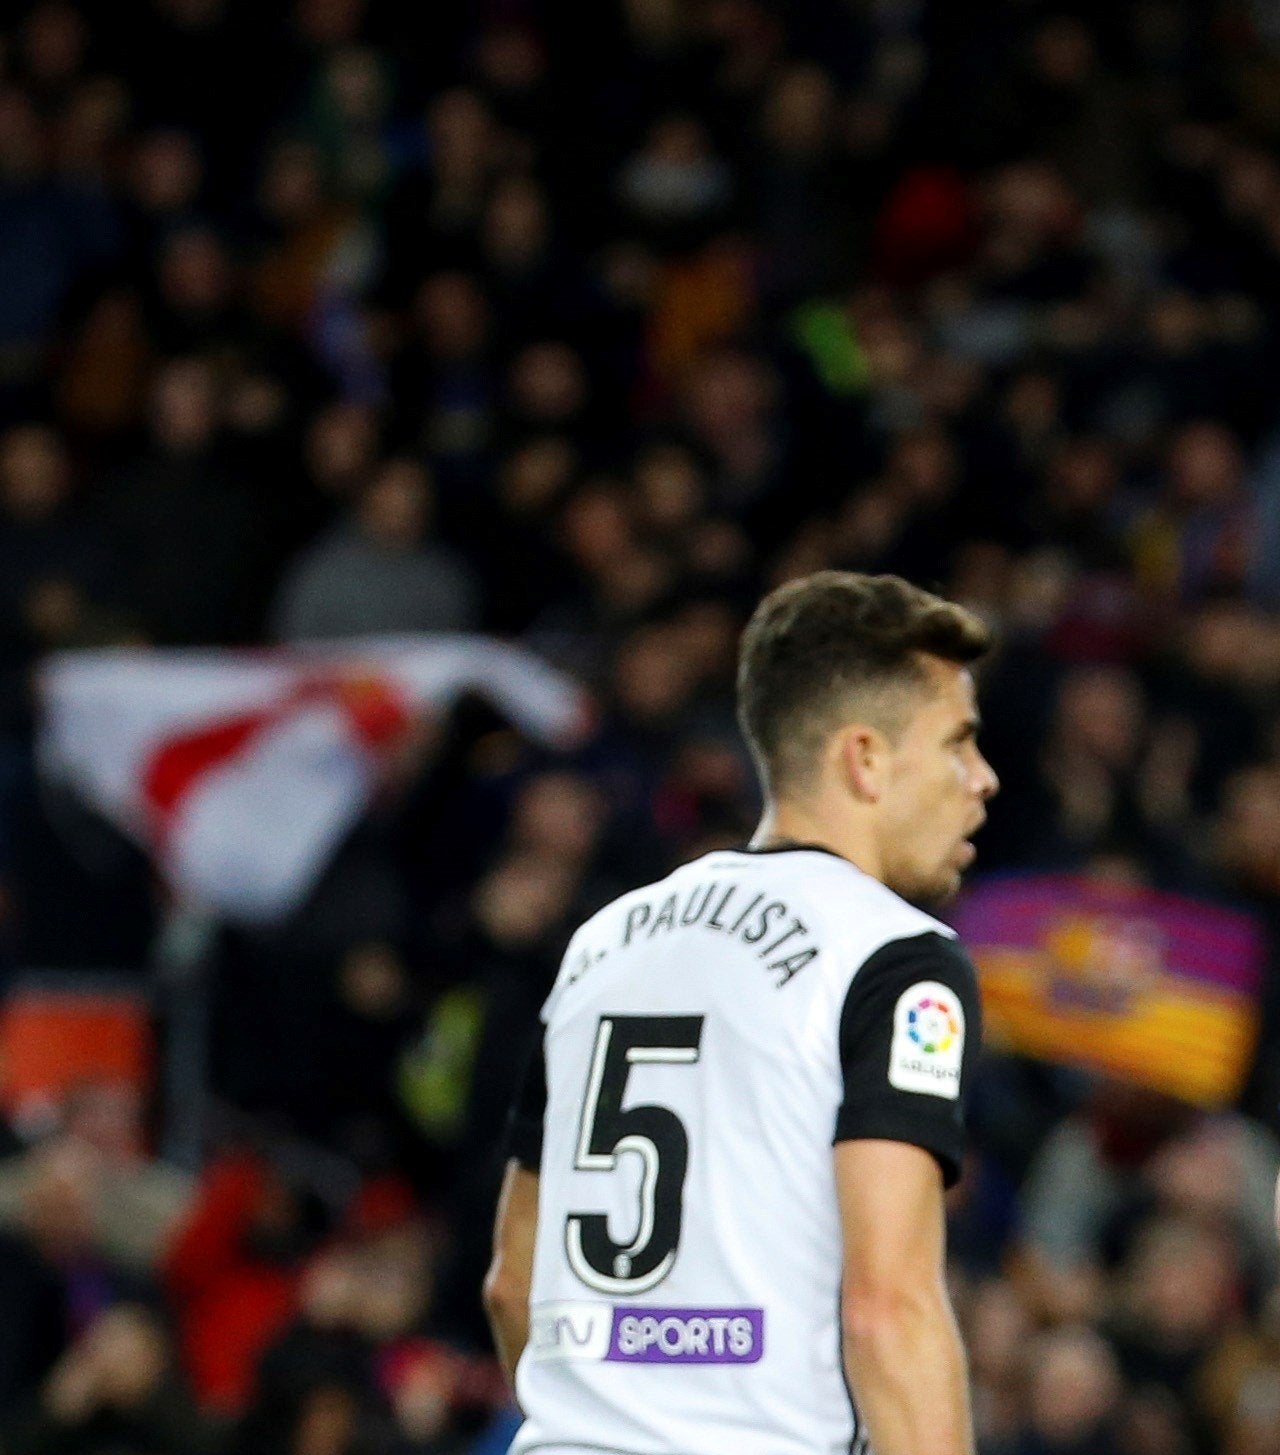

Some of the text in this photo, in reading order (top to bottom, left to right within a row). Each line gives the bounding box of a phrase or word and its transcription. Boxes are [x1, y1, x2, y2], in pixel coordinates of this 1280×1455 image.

[624, 882, 821, 988] PAULISTA
[564, 1013, 706, 1296] 5
[617, 1315, 754, 1357] SPORTS
